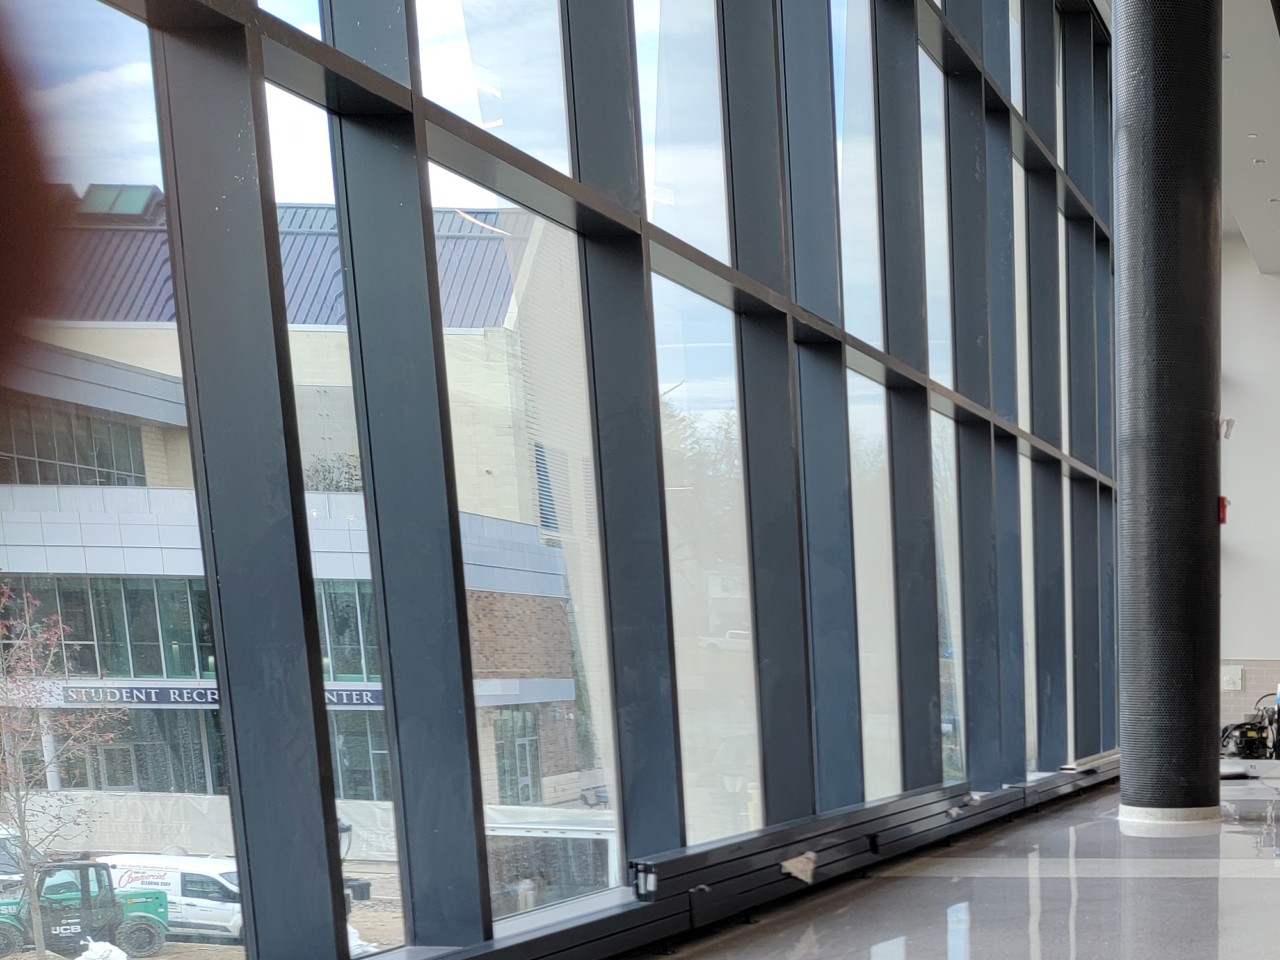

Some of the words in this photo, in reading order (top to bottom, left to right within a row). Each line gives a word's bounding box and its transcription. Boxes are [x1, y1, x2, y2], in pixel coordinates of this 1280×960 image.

[67, 687, 160, 702] STUDENT
[169, 688, 220, 703] RECR
[323, 690, 376, 704] NTER
[118, 868, 168, 889] Commercial
[51, 925, 82, 934] JCB
